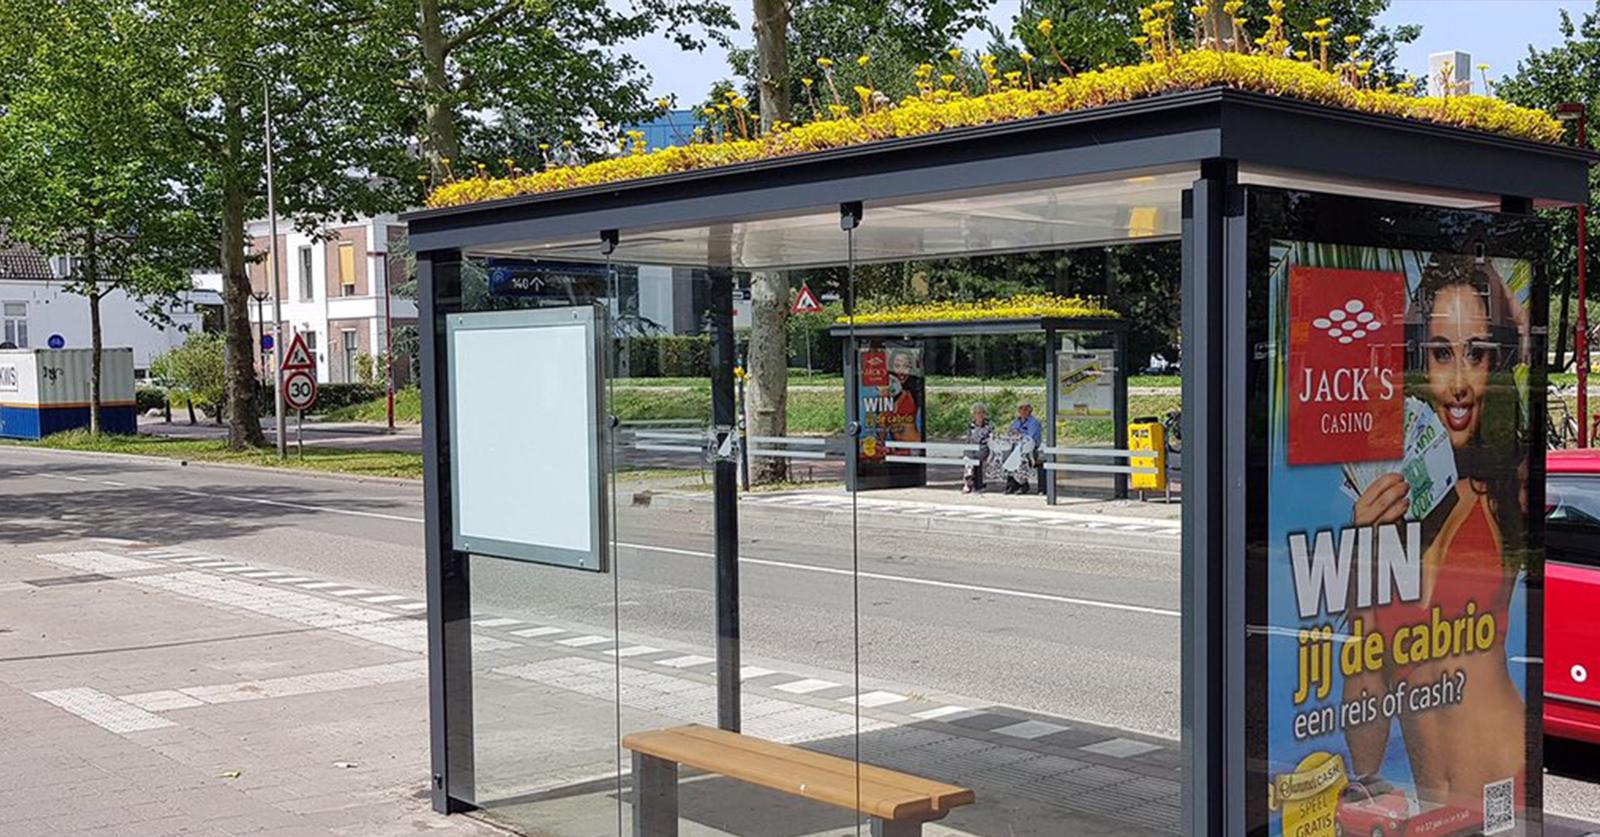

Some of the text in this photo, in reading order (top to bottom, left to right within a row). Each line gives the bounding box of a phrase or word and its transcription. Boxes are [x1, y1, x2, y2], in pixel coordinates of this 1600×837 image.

[290, 382, 311, 398] 30
[1299, 367, 1394, 403] JACK'S
[863, 396, 894, 413] WIN
[1320, 412, 1374, 434] CASINO
[1288, 521, 1421, 619] WIN
[1293, 602, 1495, 705] jij de cabrio
[1294, 671, 1466, 739] een reis of cash?
[1299, 795, 1329, 819] SPEEL
[1295, 812, 1333, 837] GRATIS
